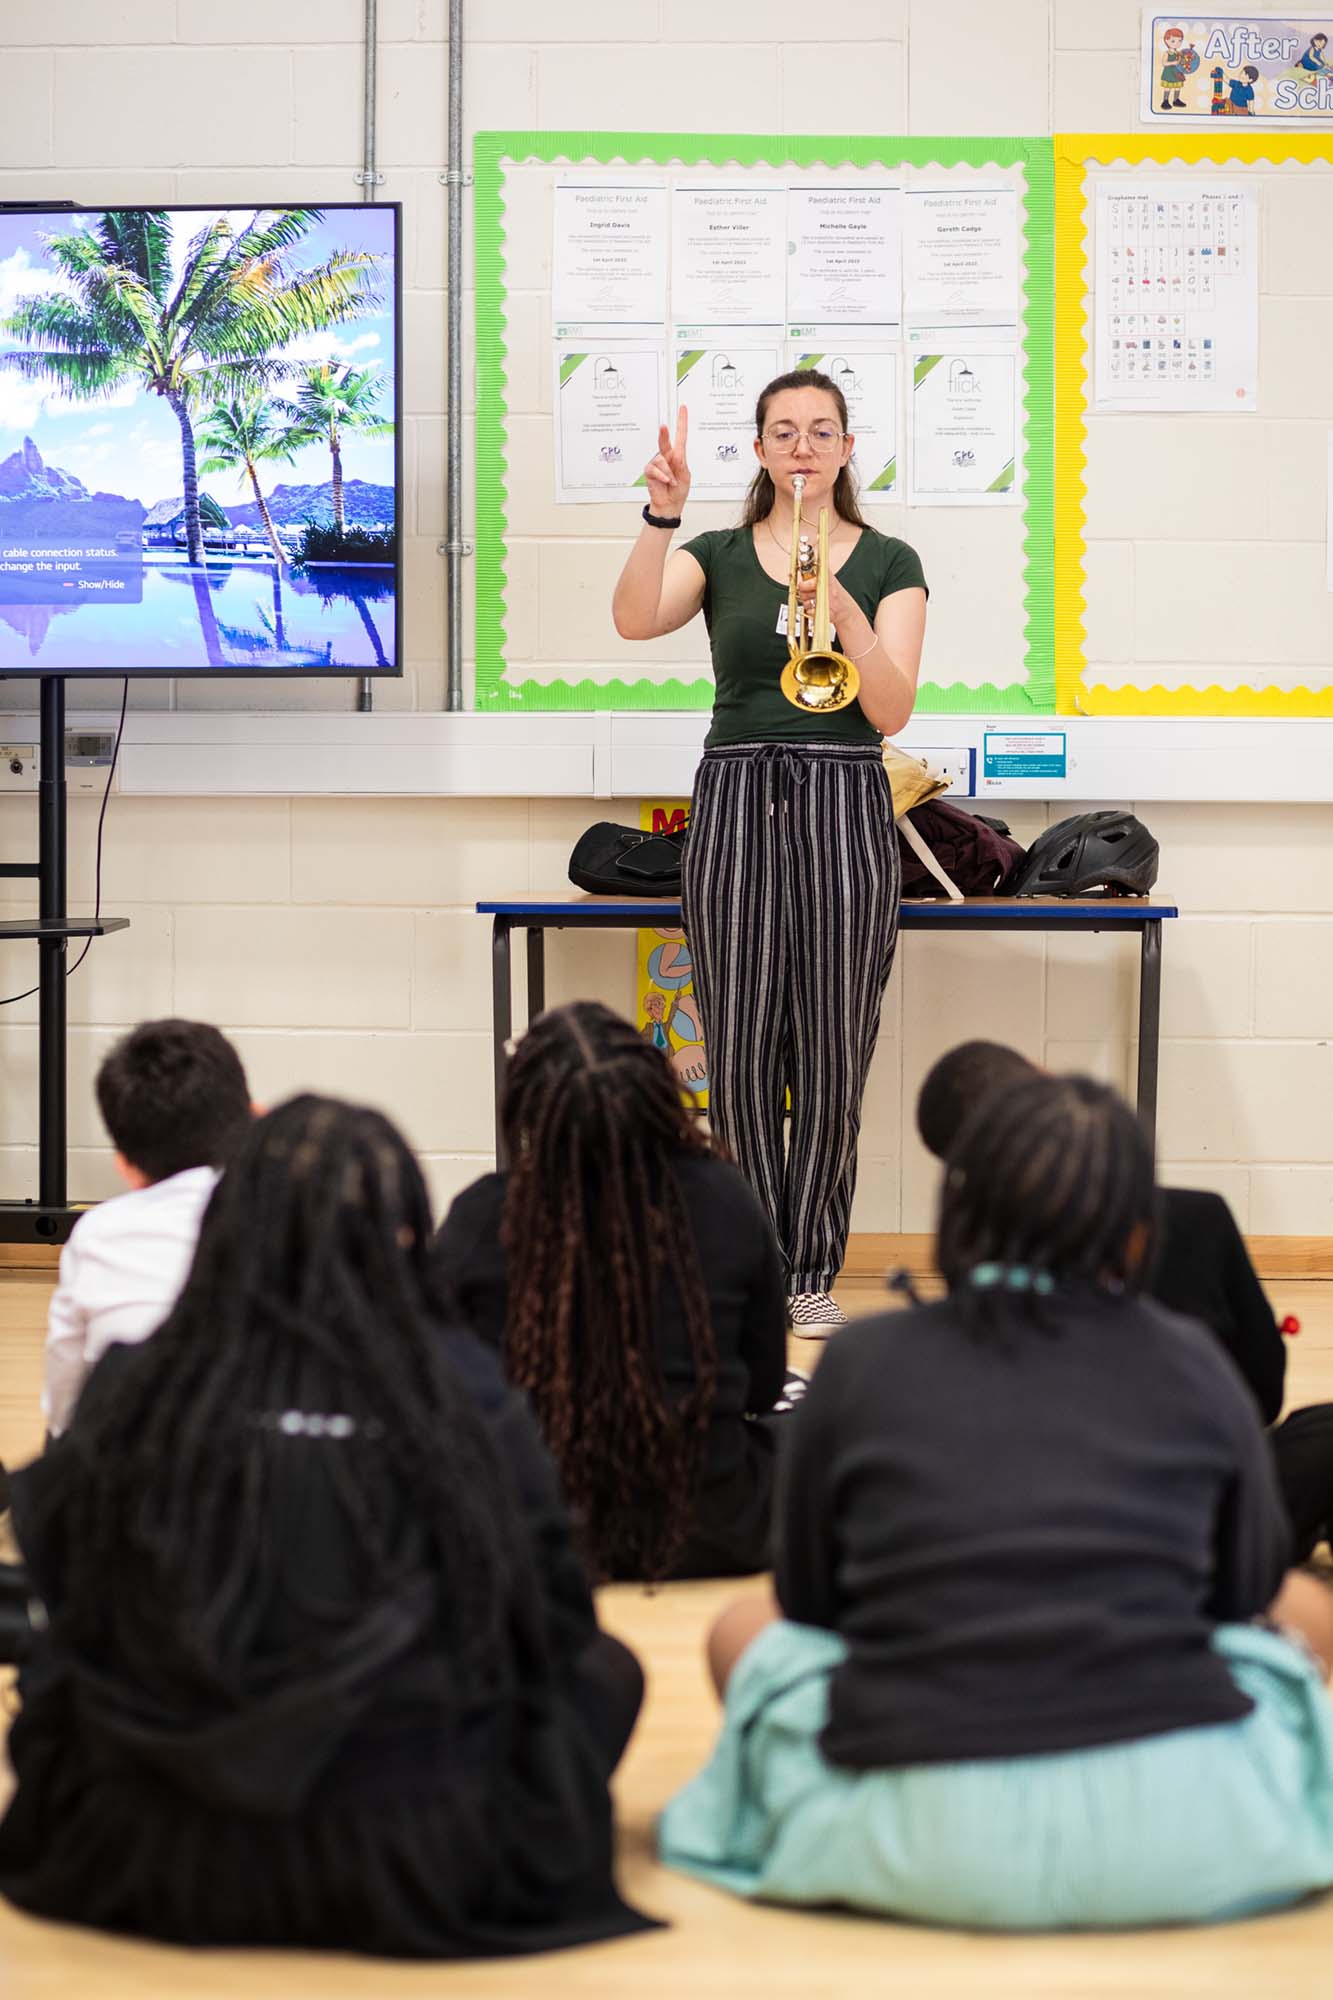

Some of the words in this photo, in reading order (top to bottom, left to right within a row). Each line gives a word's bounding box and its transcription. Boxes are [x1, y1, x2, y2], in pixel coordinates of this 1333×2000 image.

[1205, 27, 1298, 68] After
[576, 194, 614, 202] Paediatric
[616, 194, 632, 202] First
[635, 194, 648, 202] Aid
[808, 196, 846, 204] Paediatric
[848, 196, 866, 204] First
[868, 196, 881, 204] Aid
[984, 198, 996, 206] Aid
[594, 359, 626, 390] flick
[712, 356, 744, 388] flick
[948, 361, 982, 393] flick
[3, 547, 28, 558] cable
[30, 548, 83, 558] connection
[86, 548, 118, 558] status.
[0, 562, 34, 573] change
[36, 562, 52, 571] the
[55, 562, 82, 572] input.
[78, 580, 125, 590] Show/Hide
